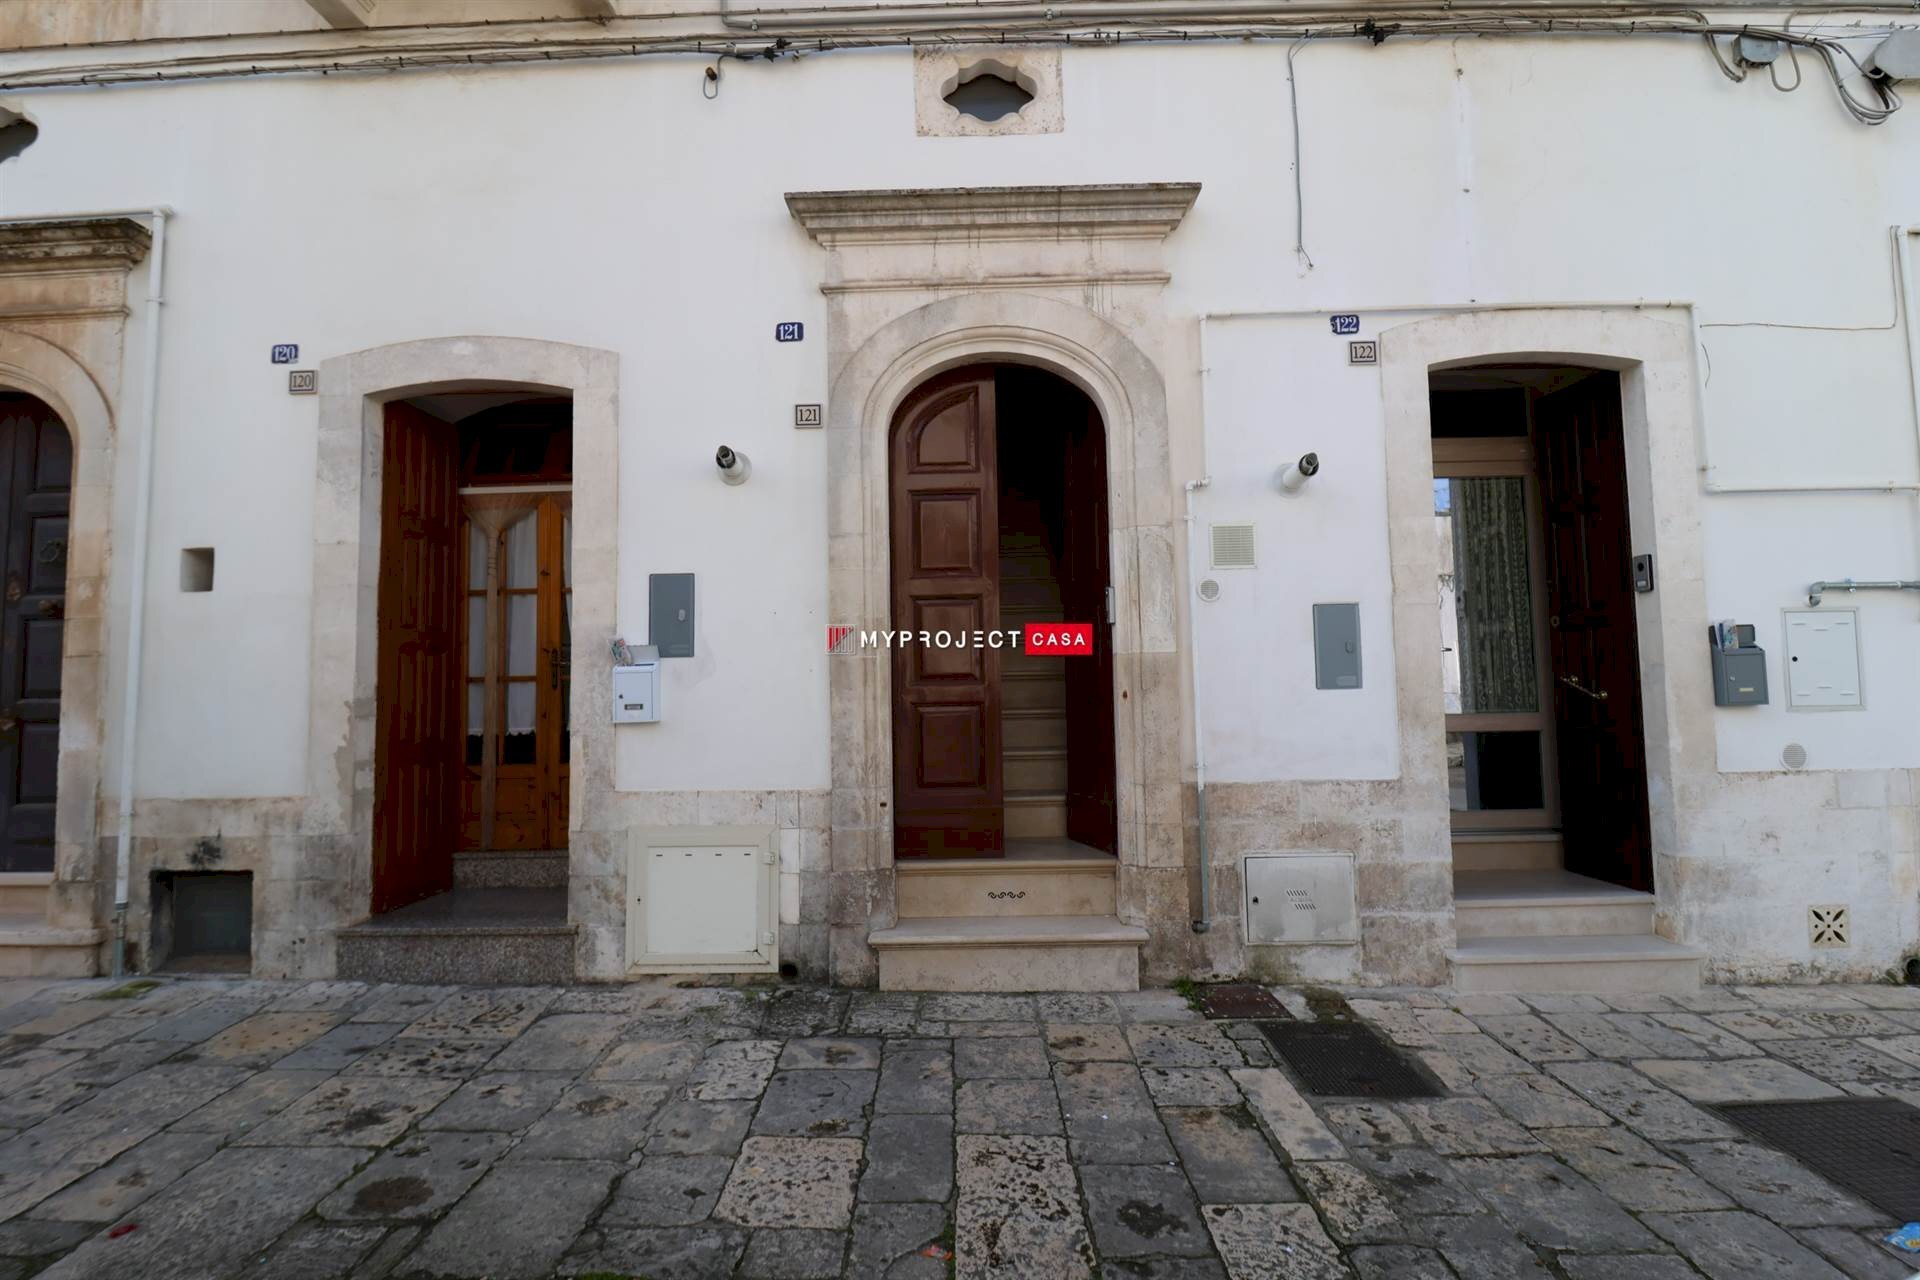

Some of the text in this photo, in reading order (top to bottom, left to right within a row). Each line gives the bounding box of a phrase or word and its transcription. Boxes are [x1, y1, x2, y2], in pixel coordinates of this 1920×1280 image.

[778, 323, 799, 340] 121
[1335, 316, 1358, 332] 122
[274, 345, 295, 361] 120
[1353, 345, 1373, 359] 122
[293, 374, 312, 388] 120
[799, 408, 817, 422] 121
